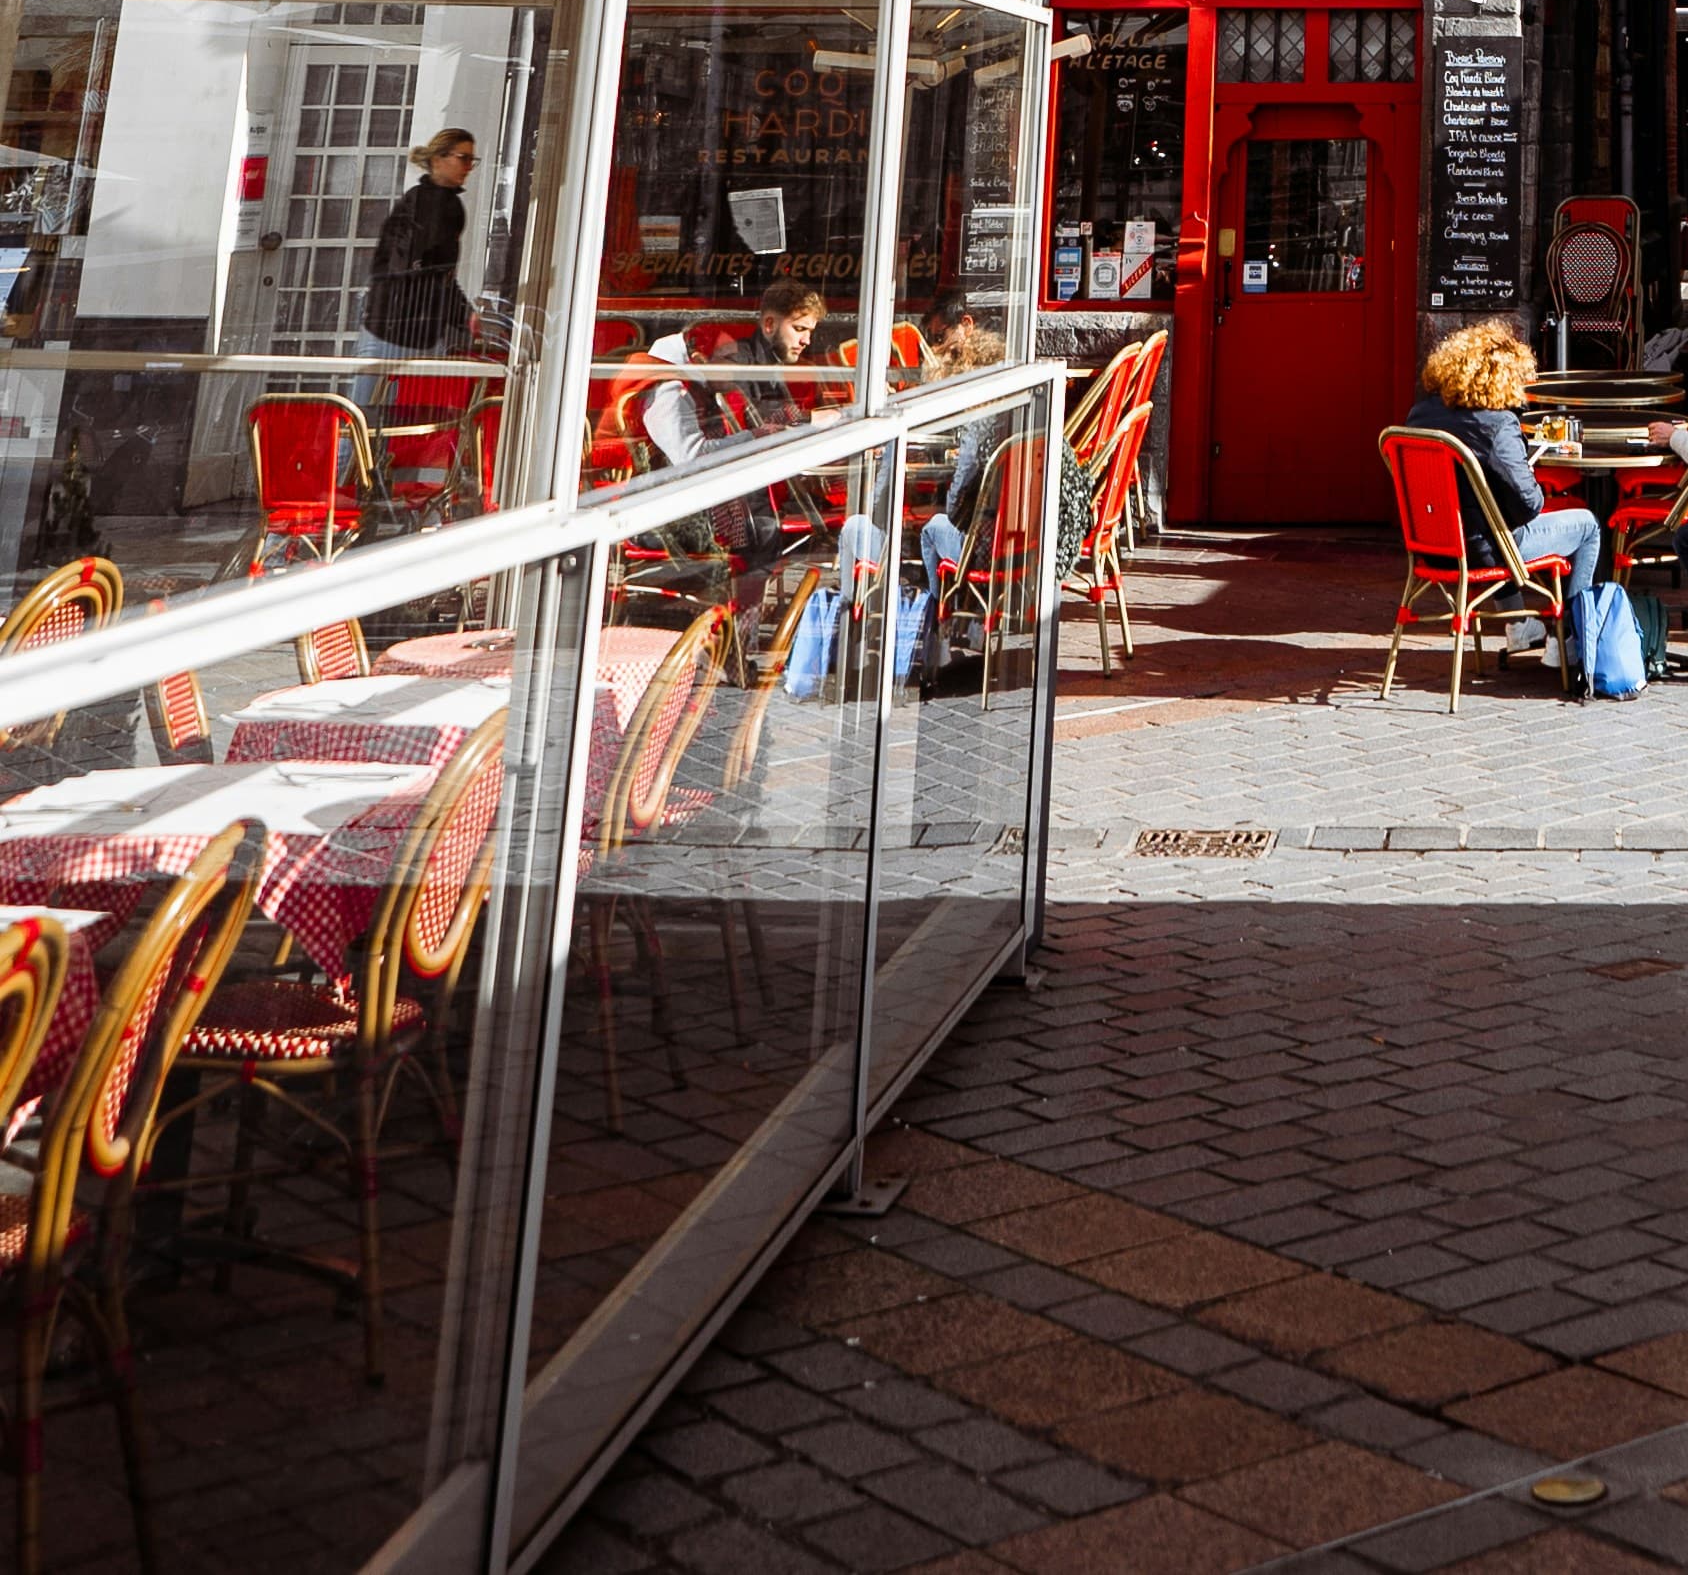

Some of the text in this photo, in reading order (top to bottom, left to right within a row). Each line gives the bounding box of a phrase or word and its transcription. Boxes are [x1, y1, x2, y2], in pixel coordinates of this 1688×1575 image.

[754, 68, 846, 106] COQ
[723, 109, 866, 138] HARDI
[1448, 129, 1469, 142] IPA
[698, 149, 869, 163] RESTAURAN
[611, 252, 751, 275] SPECIALITES
[1123, 260, 1151, 290] LICENCE
